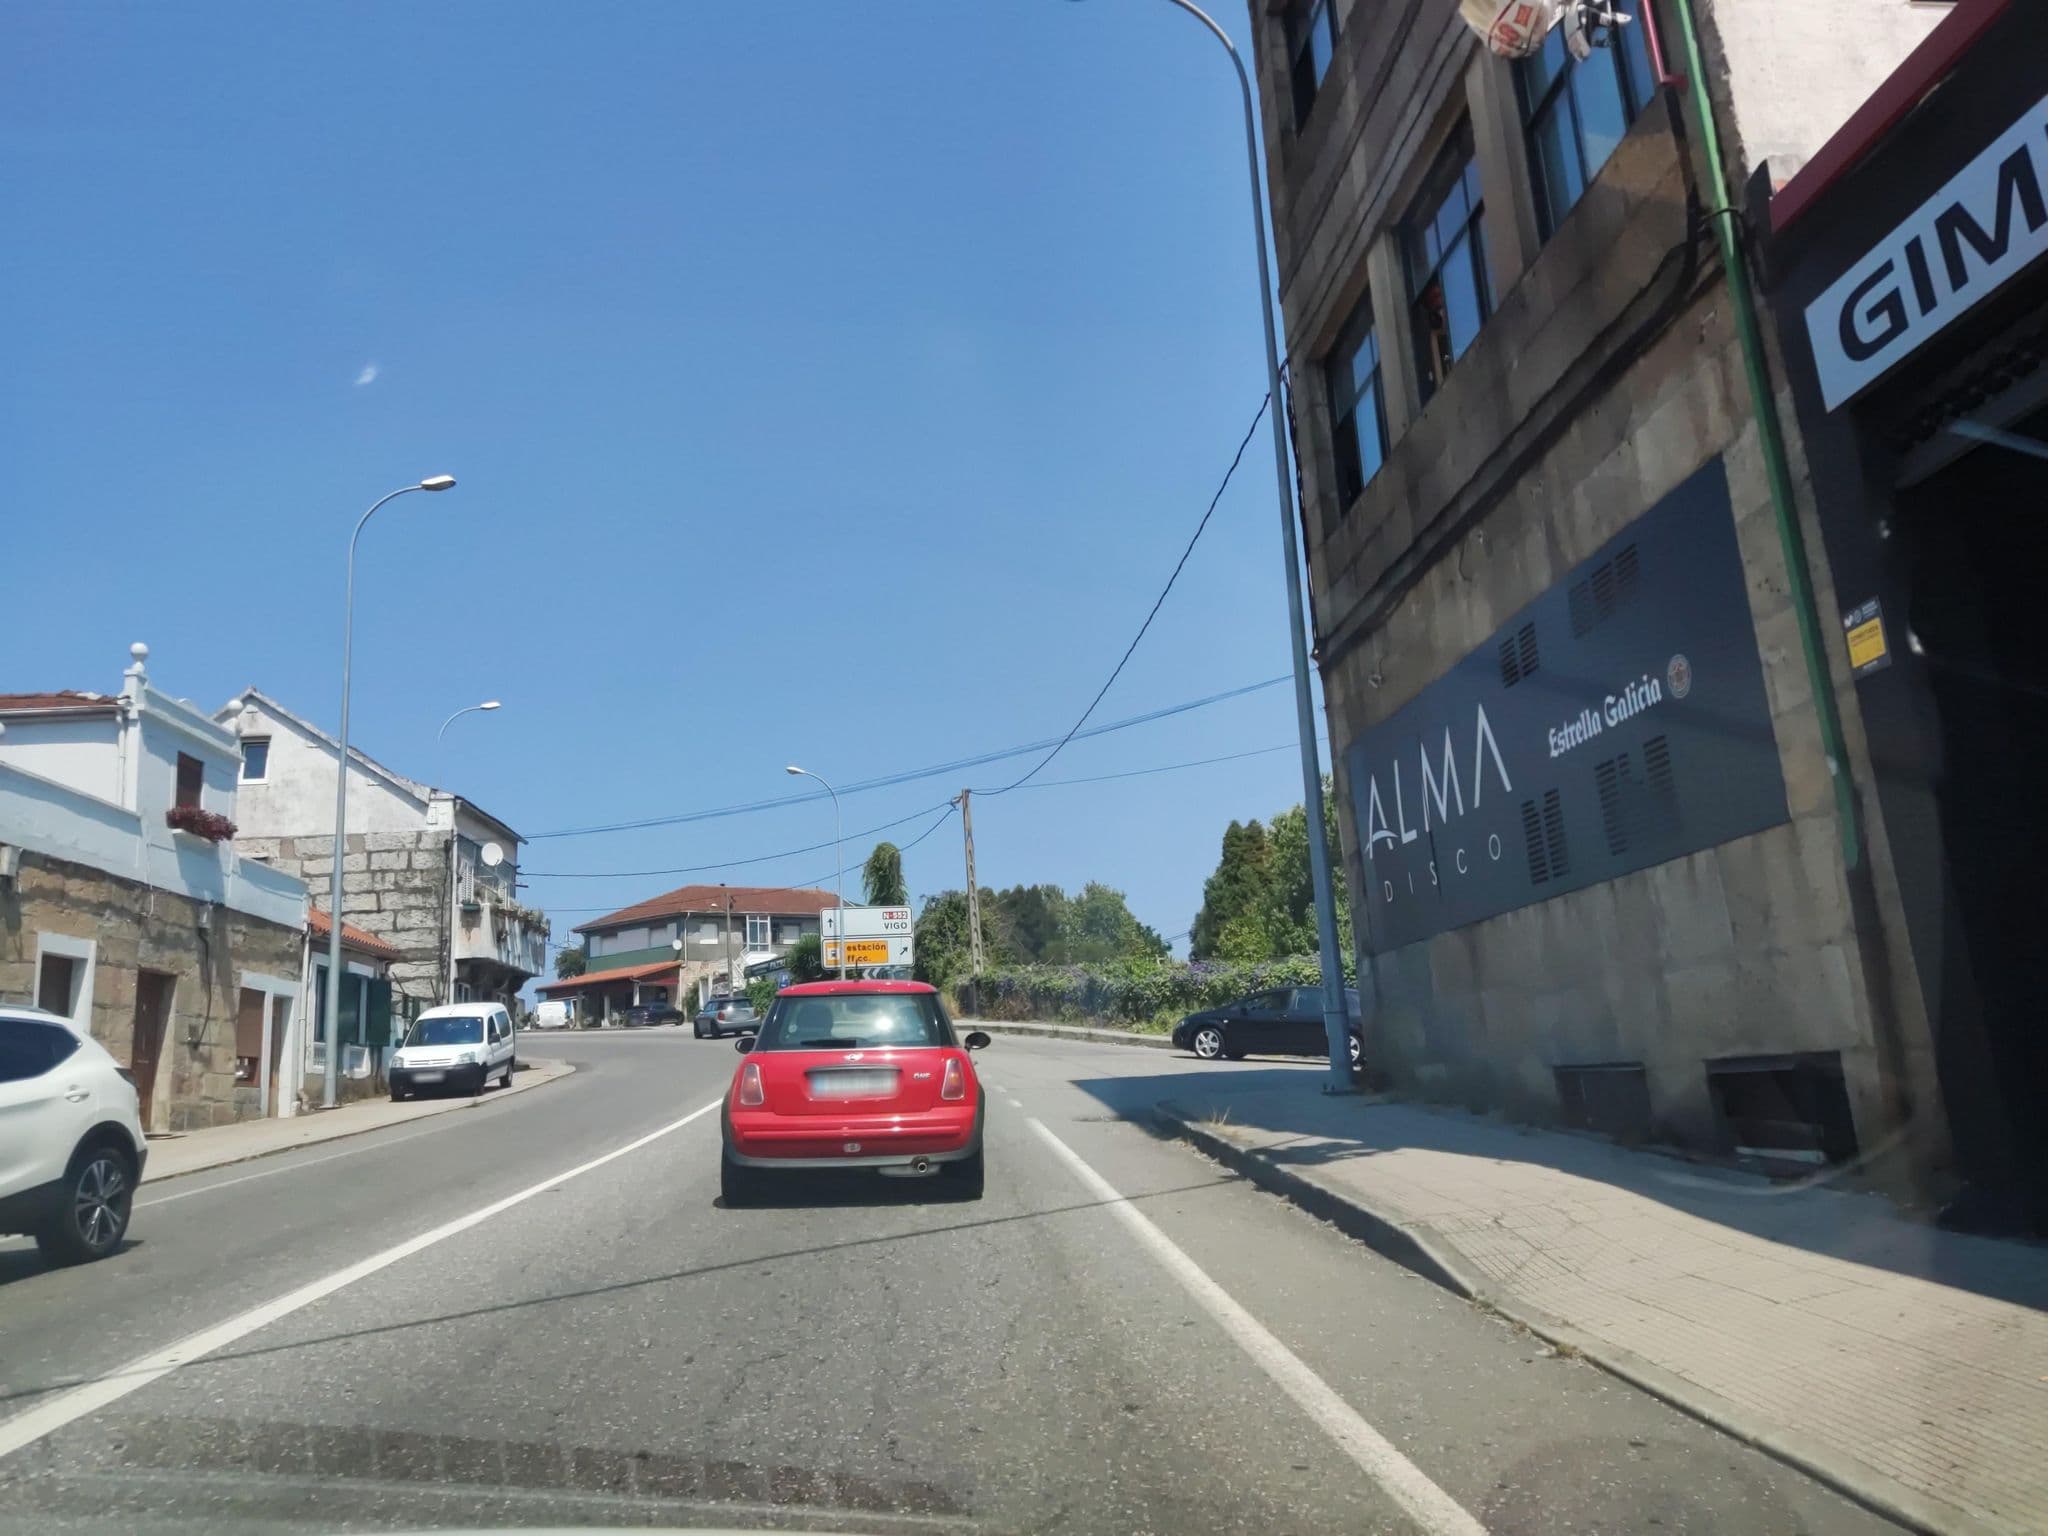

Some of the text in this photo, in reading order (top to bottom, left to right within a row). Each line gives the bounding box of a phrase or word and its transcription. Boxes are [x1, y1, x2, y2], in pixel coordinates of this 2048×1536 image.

[1839, 121, 2048, 362] GIM
[1549, 674, 1663, 758] Estrella Galicia
[1364, 703, 1513, 860] ALMA
[1384, 833, 1502, 902] DISCO
[846, 943, 886, 952] estación
